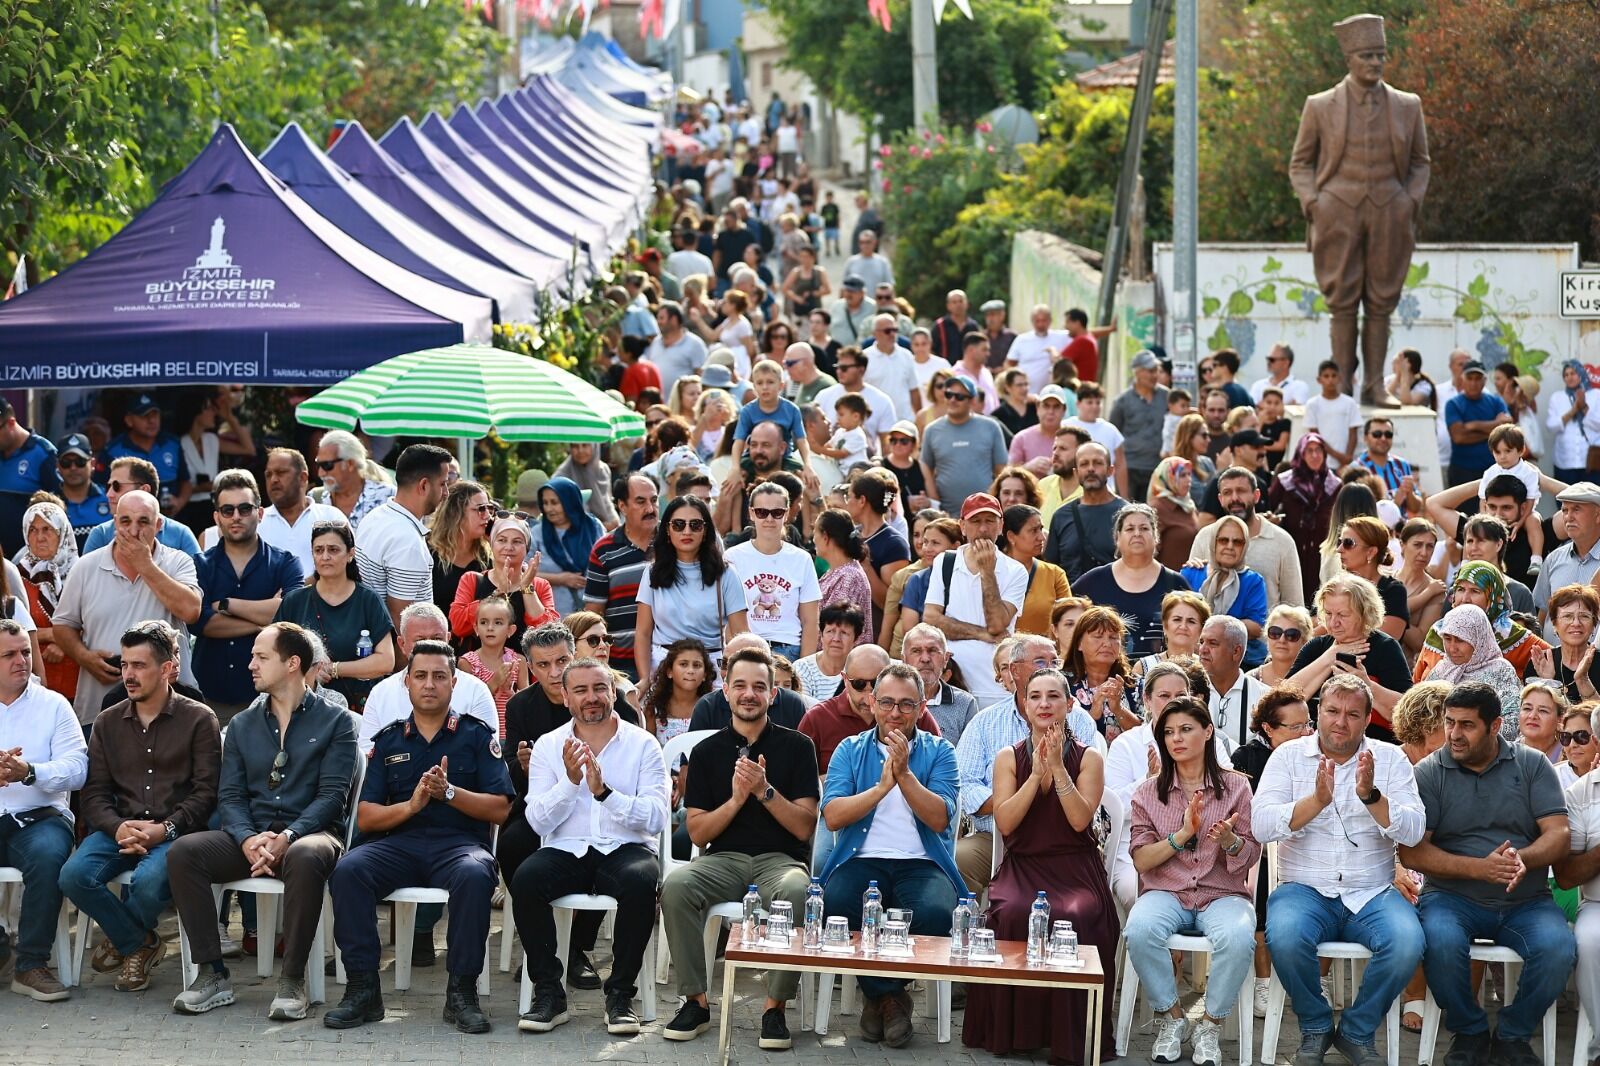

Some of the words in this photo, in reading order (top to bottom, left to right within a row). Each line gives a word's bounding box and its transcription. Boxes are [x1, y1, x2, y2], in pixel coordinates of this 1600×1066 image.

[183, 267, 242, 280] İZMİR
[145, 278, 275, 294] BÜYÜKŞEHİR
[149, 290, 268, 303] BELEDİYESİ
[5, 364, 52, 381] İZMİR
[56, 362, 160, 380] BÜYÜKŞEHİR
[165, 360, 259, 377] BELEDİYESİ
[744, 573, 791, 591] HAPPIER
